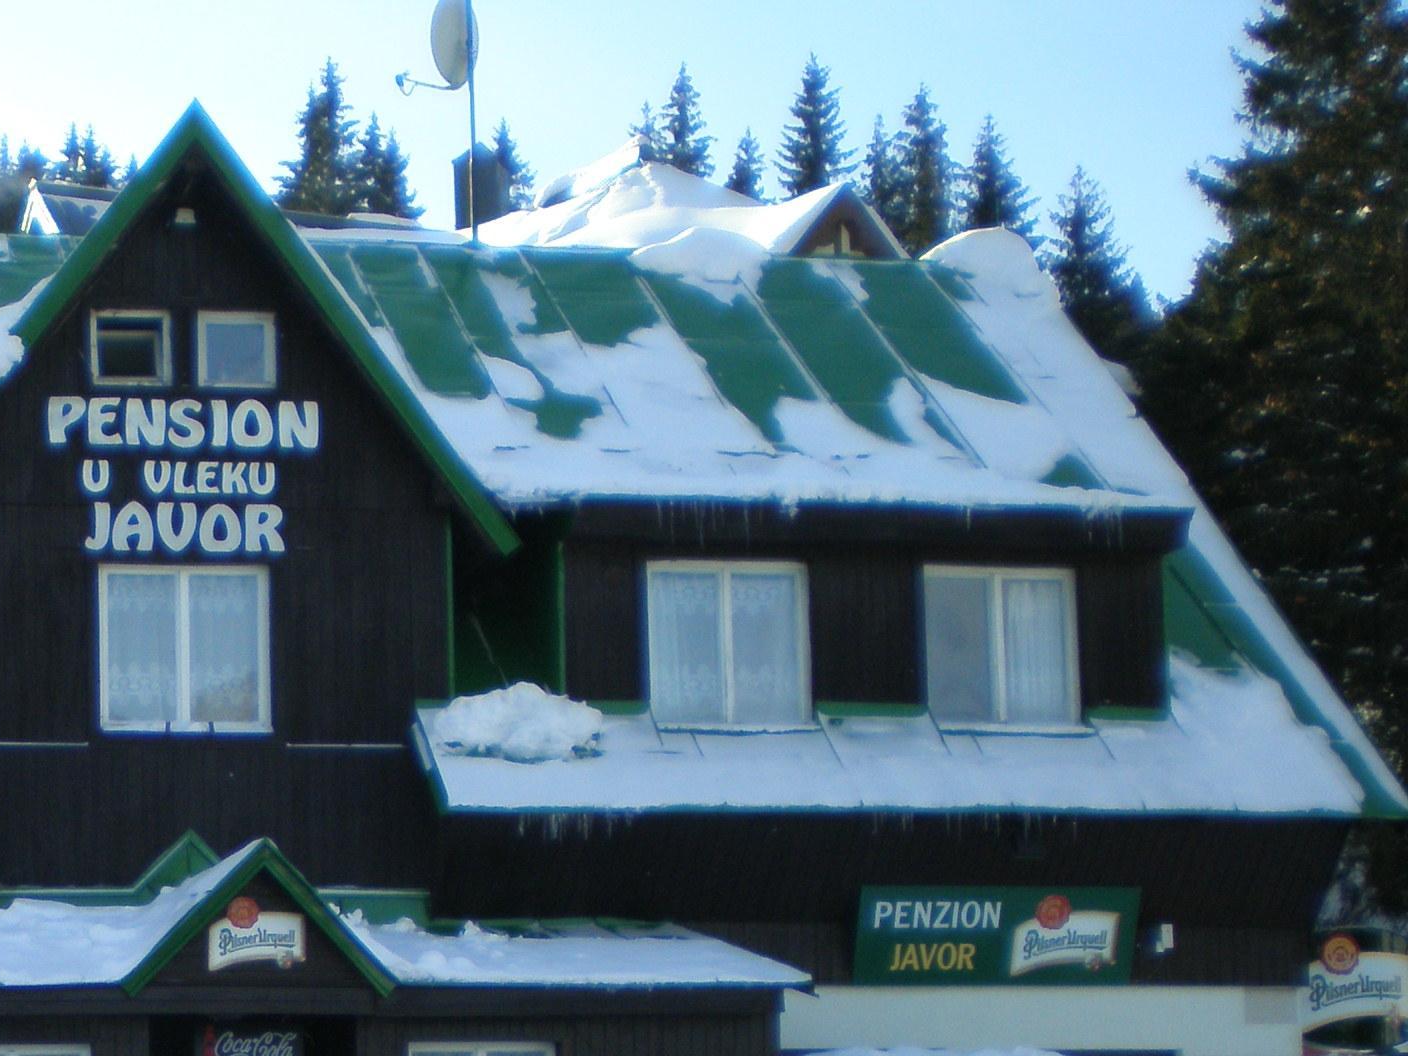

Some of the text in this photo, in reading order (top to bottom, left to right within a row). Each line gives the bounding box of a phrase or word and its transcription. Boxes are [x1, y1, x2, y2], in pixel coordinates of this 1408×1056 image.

[48, 396, 319, 449] PENSION
[82, 459, 276, 495] U VLEKU
[85, 500, 286, 552] JAVOR
[874, 901, 1002, 929] PENZION
[219, 928, 295, 956] Pilsner Urquell
[890, 943, 977, 971] JAVOR
[1023, 928, 1106, 960] Pilsner Urquell
[1309, 974, 1402, 1011] Pilsner Urquell
